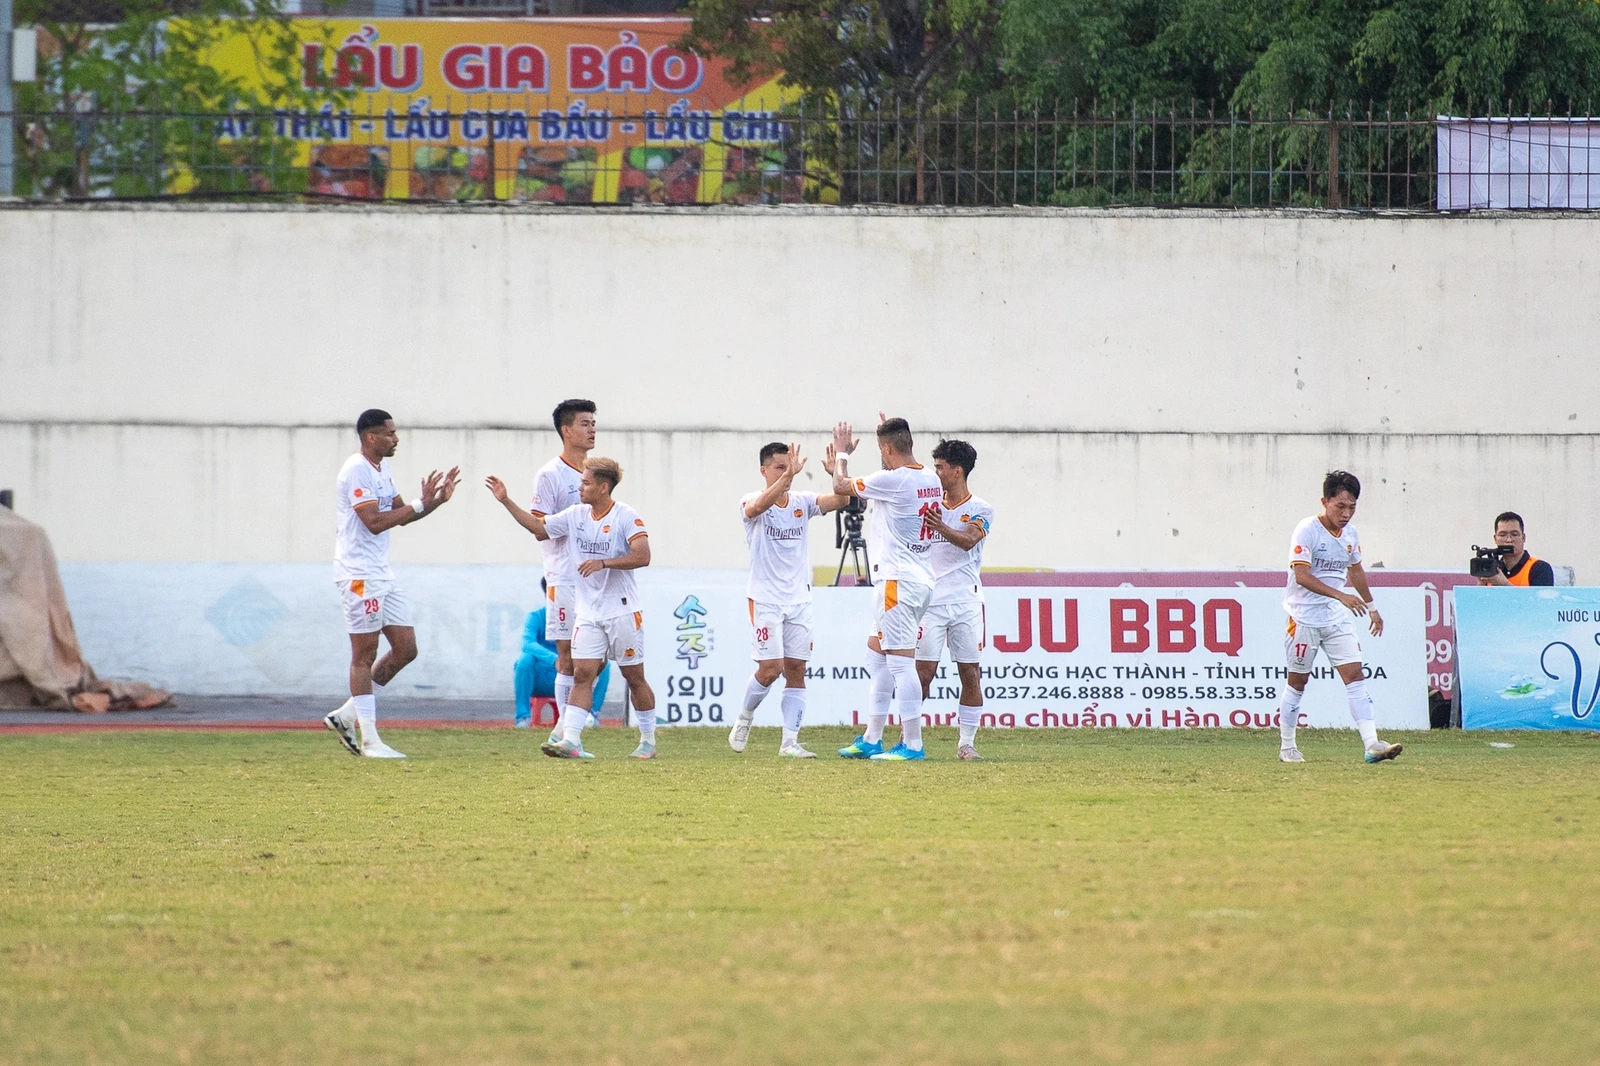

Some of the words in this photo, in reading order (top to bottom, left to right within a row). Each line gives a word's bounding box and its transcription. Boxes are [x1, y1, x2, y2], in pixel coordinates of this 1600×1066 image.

[302, 24, 420, 92] LẨU
[442, 44, 549, 93] GIA
[567, 31, 703, 93] BẢO
[364, 598, 380, 615] 29
[558, 607, 566, 622] 5
[756, 627, 769, 642] 28
[982, 598, 1079, 653] JU
[1109, 598, 1244, 657] BBQ
[1295, 643, 1308, 658] 17
[832, 667, 871, 680] MIN
[979, 662, 1059, 680] HƯỜNG
[1066, 665, 1107, 683] HẠC
[1113, 663, 1186, 680] THÀNH
[1204, 661, 1256, 680] TỈNH
[1262, 666, 1335, 680] THNH
[1361, 662, 1388, 680] ÓA
[666, 675, 724, 701] SOJU
[984, 686, 1125, 700] 0237.246.8888
[1142, 686, 1277, 700] 0985.58.33.58
[667, 703, 724, 723] BBQ
[1024, 702, 1117, 728] chuẩn
[1162, 706, 1220, 728] Hàn
